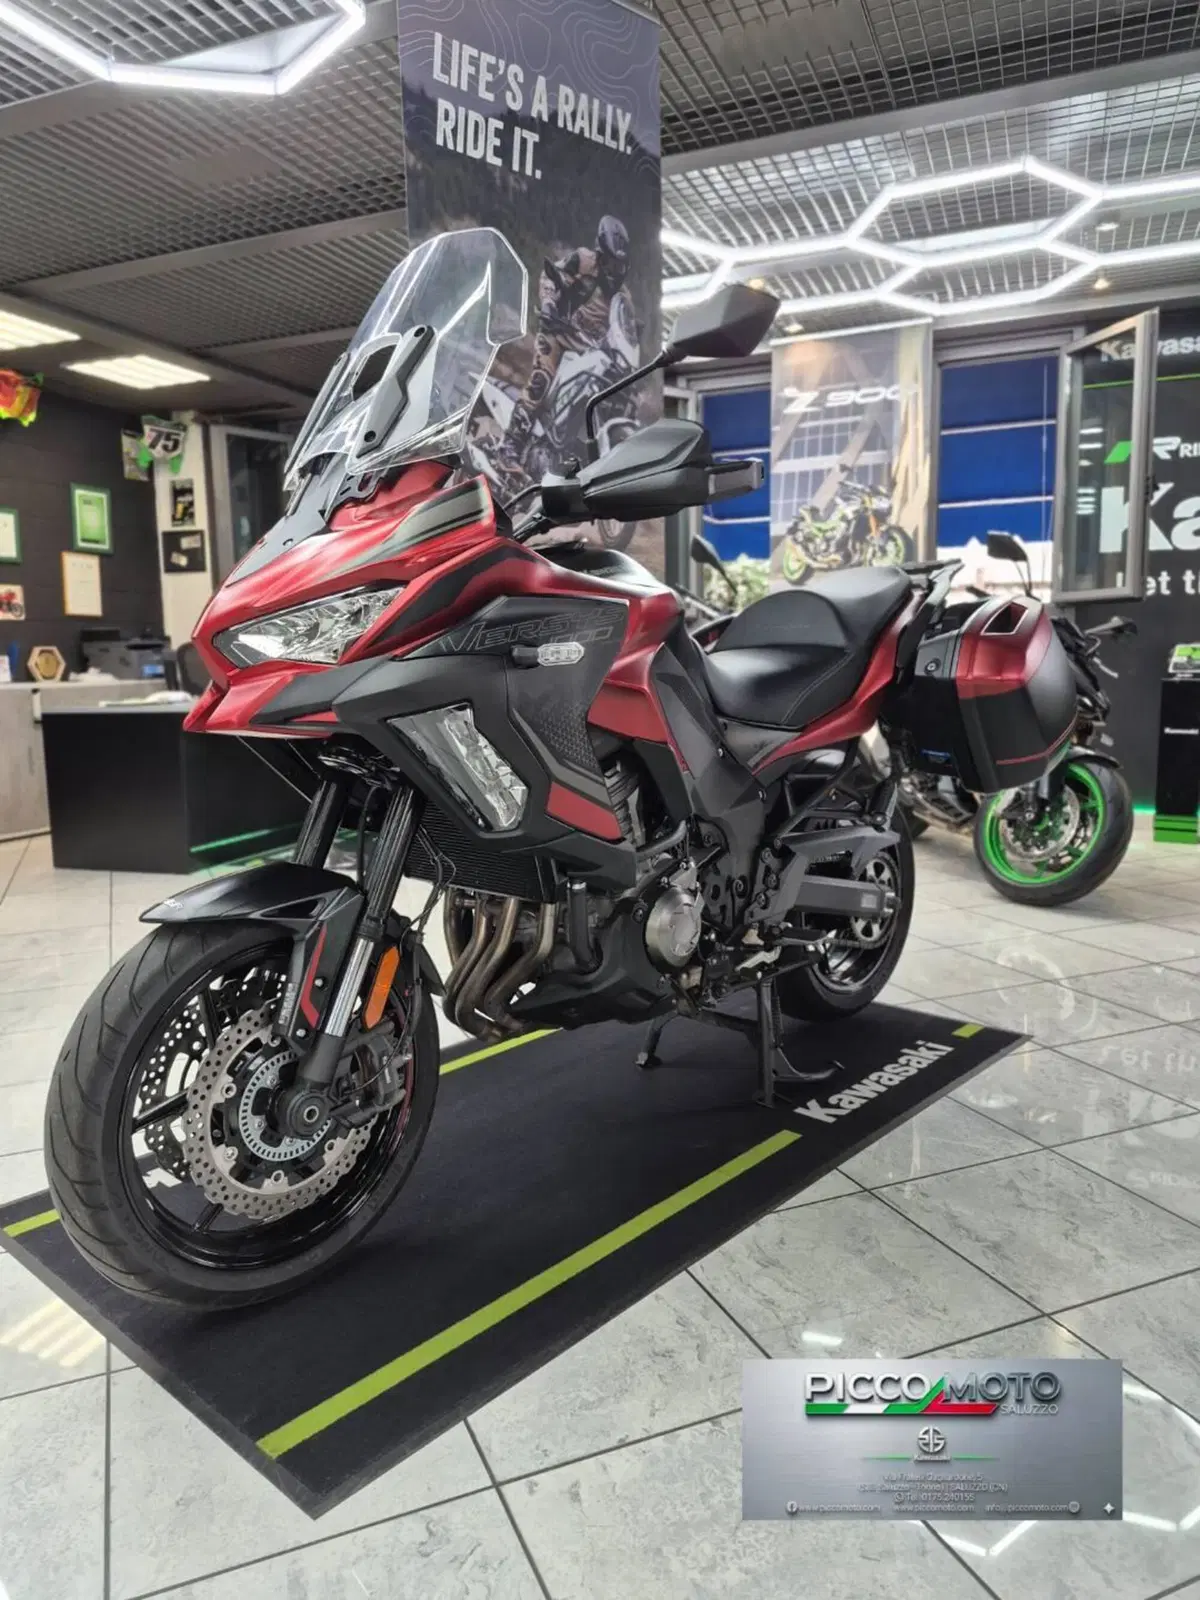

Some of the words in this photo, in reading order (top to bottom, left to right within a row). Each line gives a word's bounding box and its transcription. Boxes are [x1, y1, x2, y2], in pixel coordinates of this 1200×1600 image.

[433, 32, 524, 111] LIFE'S
[531, 75, 549, 122] A
[557, 84, 632, 155] RALLY.
[436, 98, 504, 167] RIDE
[512, 126, 542, 180] IT.
[148, 428, 181, 453] 75
[793, 1040, 955, 1124] Kawasaki
